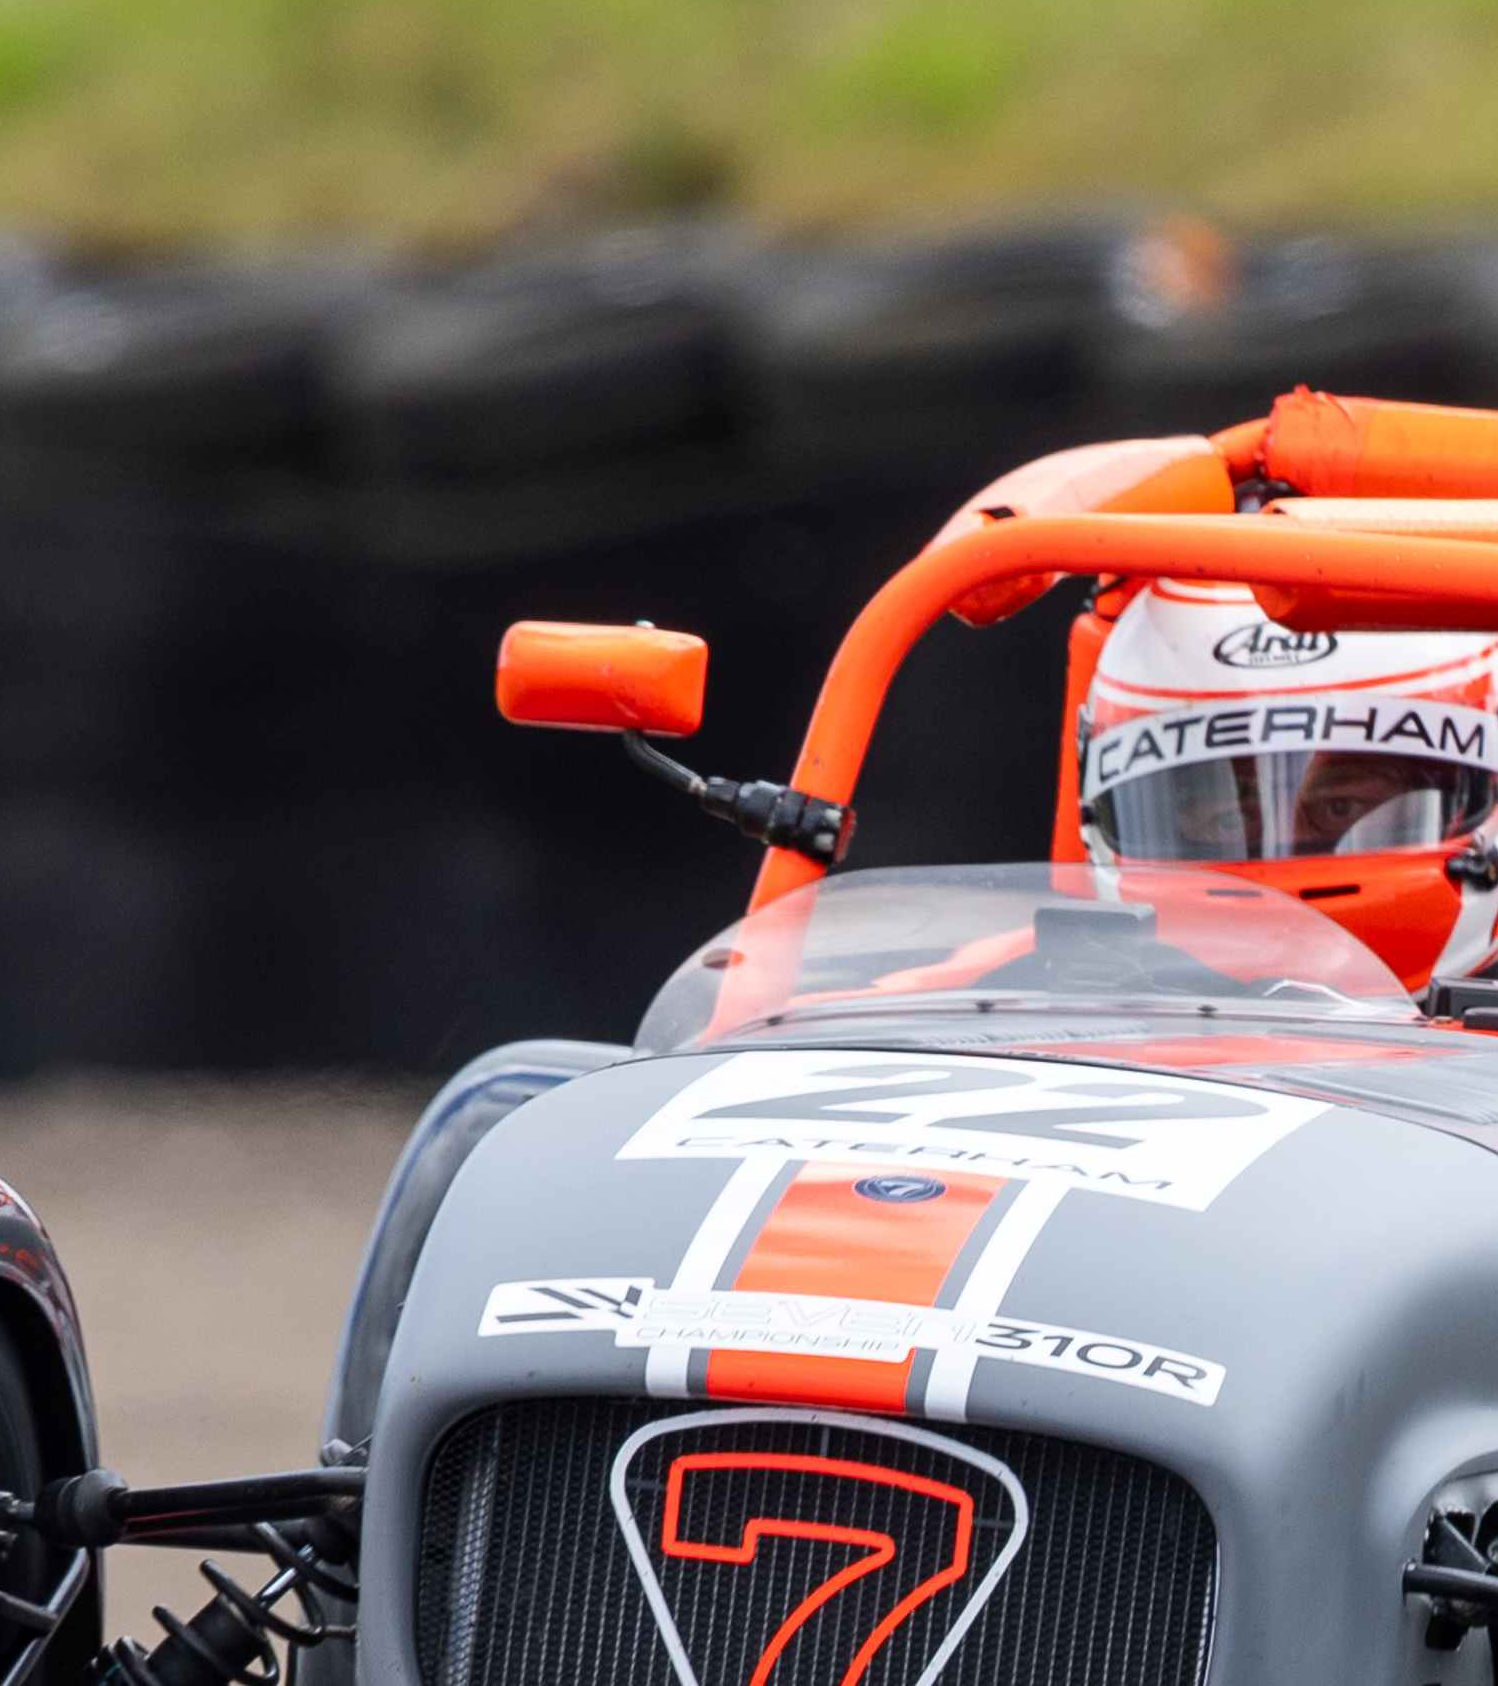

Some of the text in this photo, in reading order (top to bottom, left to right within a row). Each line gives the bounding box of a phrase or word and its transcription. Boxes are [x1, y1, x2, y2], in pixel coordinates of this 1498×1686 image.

[1098, 706, 1485, 784] CATERHAM
[691, 1063, 1270, 1150] 22
[676, 1135, 1175, 1190] CATERHAM
[635, 1326, 900, 1352] CHAMPIONSHIP
[975, 1322, 1208, 1390] 310R
